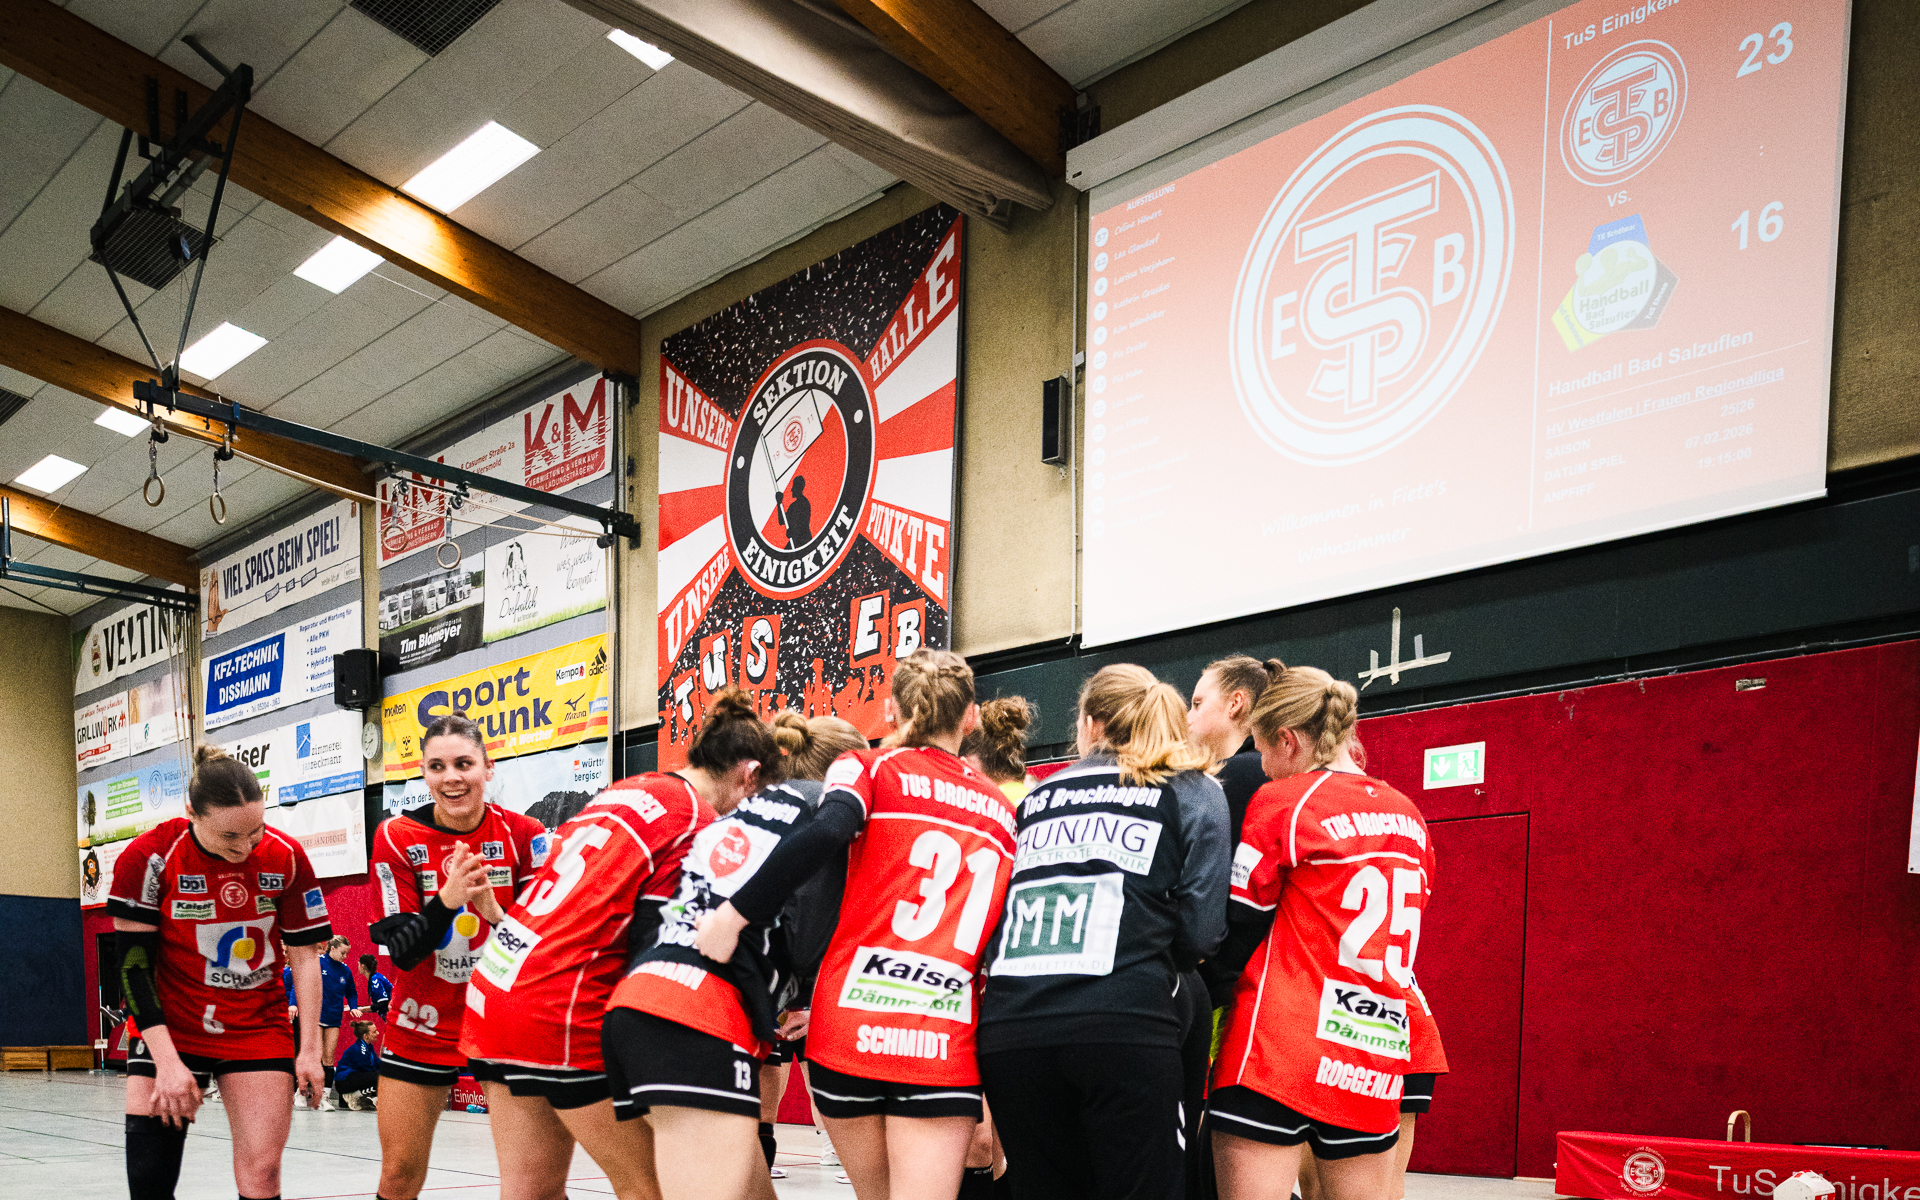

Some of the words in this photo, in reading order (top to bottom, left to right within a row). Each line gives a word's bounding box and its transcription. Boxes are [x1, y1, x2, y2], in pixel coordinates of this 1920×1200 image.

[1563, 24, 1597, 50] TuS
[1736, 21, 1795, 79] 23
[1127, 184, 1176, 211] AUFSTELLUNG
[1730, 200, 1785, 251] 16
[871, 232, 957, 383] HALLE
[1579, 279, 1650, 313] Handball
[1585, 308, 1605, 321] Bad
[1588, 309, 1637, 330] Salzuflen
[1548, 363, 1624, 398] Handball
[1627, 352, 1663, 376] Bad
[1667, 329, 1754, 364] Salzuflen
[665, 364, 733, 452] UNSERE
[751, 357, 849, 427] SEKTION
[1546, 422, 1566, 438] HV
[1567, 404, 1634, 432] Westfalen
[1643, 390, 1692, 413] Frauen
[1694, 366, 1785, 400] Regionalliga
[523, 375, 607, 477] K&M
[1543, 461, 1588, 483] DATUM
[1590, 452, 1627, 473] SPIEL
[1685, 422, 1754, 451] 07.02.2026
[1544, 438, 1591, 461] SAISON
[529, 466, 565, 487] VERMIETUNG
[572, 451, 599, 468] VERKAUF
[1543, 482, 1595, 504] ANPFIFF
[1696, 446, 1753, 471] 19:15:00
[1260, 502, 1362, 538] Willkommen
[1367, 493, 1385, 512] in
[1391, 478, 1448, 507] Fiete's
[222, 563, 243, 600] VIEL
[245, 546, 275, 591] SPASS
[277, 533, 304, 576] BEIM
[306, 516, 340, 564] SPIEL!
[742, 505, 854, 586] EINIGKEIT
[870, 501, 946, 601] PUNKTE
[1297, 526, 1412, 564] Wohnzimmer
[300, 620, 319, 634] Reparatur
[319, 617, 328, 627] und
[328, 611, 346, 627] Wartung
[663, 544, 731, 664] UNSERE
[310, 644, 327, 656] E-Autos
[400, 638, 417, 654] Tim
[418, 623, 462, 650] Blomeyer
[213, 641, 281, 683] KFZ-TECHNIK
[556, 667, 579, 681] Kempa
[219, 670, 271, 706] DISSMANN
[417, 666, 531, 735] Sport
[508, 735, 517, 748] in
[518, 728, 553, 746] Werther
[389, 798, 399, 808] Ihr
[417, 792, 428, 803] der
[899, 772, 933, 800] TUS
[1023, 789, 1051, 820] TuS
[1050, 783, 1163, 809] Brockhagen
[1321, 813, 1357, 842] TUS
[176, 901, 214, 910] Kaiser
[891, 829, 1001, 957] 31
[1011, 893, 1089, 949] MM
[1338, 864, 1422, 989] 25
[396, 997, 439, 1036] 22
[857, 1024, 951, 1061] SCHMIDT
[733, 1059, 752, 1091] 13
[1708, 1164, 1777, 1197] TuS
